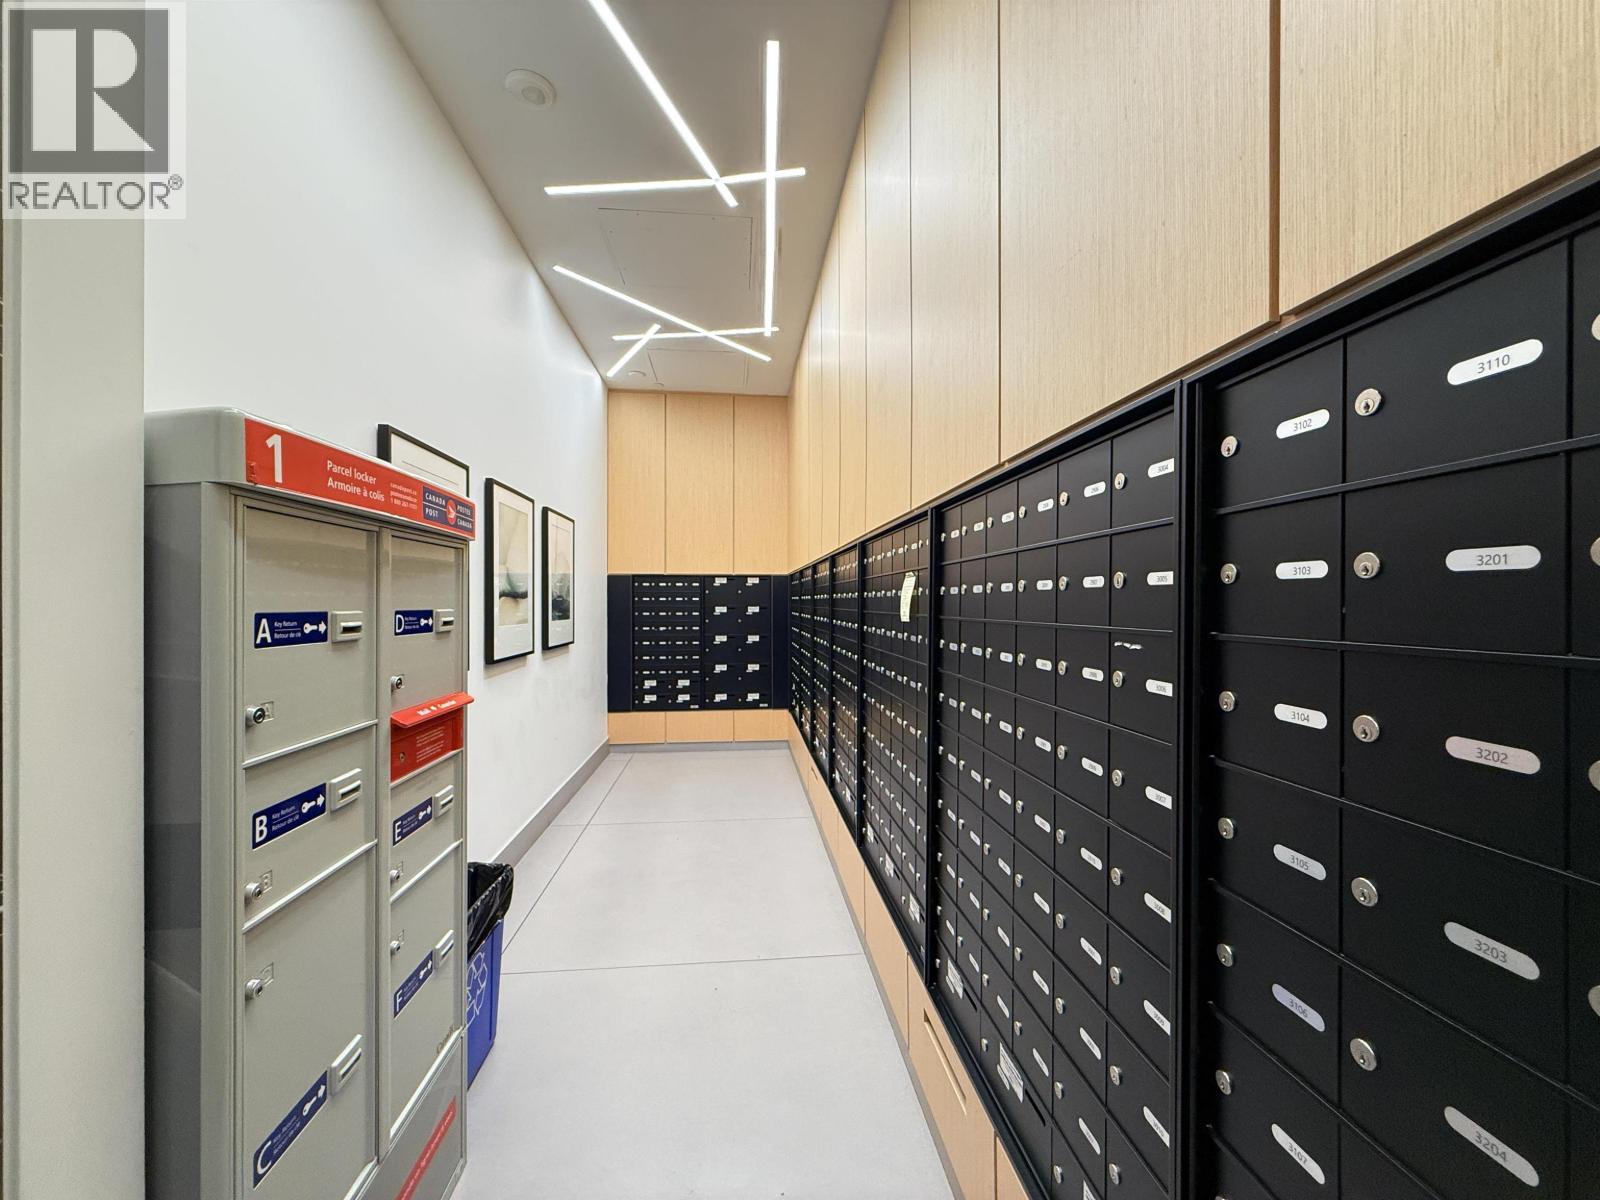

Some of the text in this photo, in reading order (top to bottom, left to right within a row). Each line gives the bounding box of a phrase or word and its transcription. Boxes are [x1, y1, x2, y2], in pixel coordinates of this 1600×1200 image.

[1477, 353, 1511, 374] 3110
[1293, 418, 1313, 432] 3102
[266, 433, 283, 484] 1
[327, 460, 377, 485] Parcel locker
[327, 477, 361, 495] Armoire
[362, 486, 369, 498] à
[369, 490, 385, 502] colis
[425, 492, 446, 507] CANADA
[425, 507, 439, 518] POST
[457, 504, 471, 516] POSTES
[457, 518, 472, 529] CANADA
[1476, 553, 1509, 566] 3201
[1292, 565, 1312, 576] 3103
[255, 618, 272, 644] A
[274, 621, 283, 629] Key
[395, 614, 405, 633] D
[1290, 711, 1311, 723] 3104
[1475, 747, 1509, 765] 3202
[255, 815, 268, 843] B
[395, 820, 402, 842] E
[1289, 854, 1310, 871] 3105
[1474, 938, 1508, 964] 3203
[396, 989, 403, 1012] F
[1288, 998, 1309, 1018] 3106
[1287, 1142, 1308, 1165] 3107
[1474, 1131, 1508, 1163] 3204
[256, 1140, 272, 1175] C
